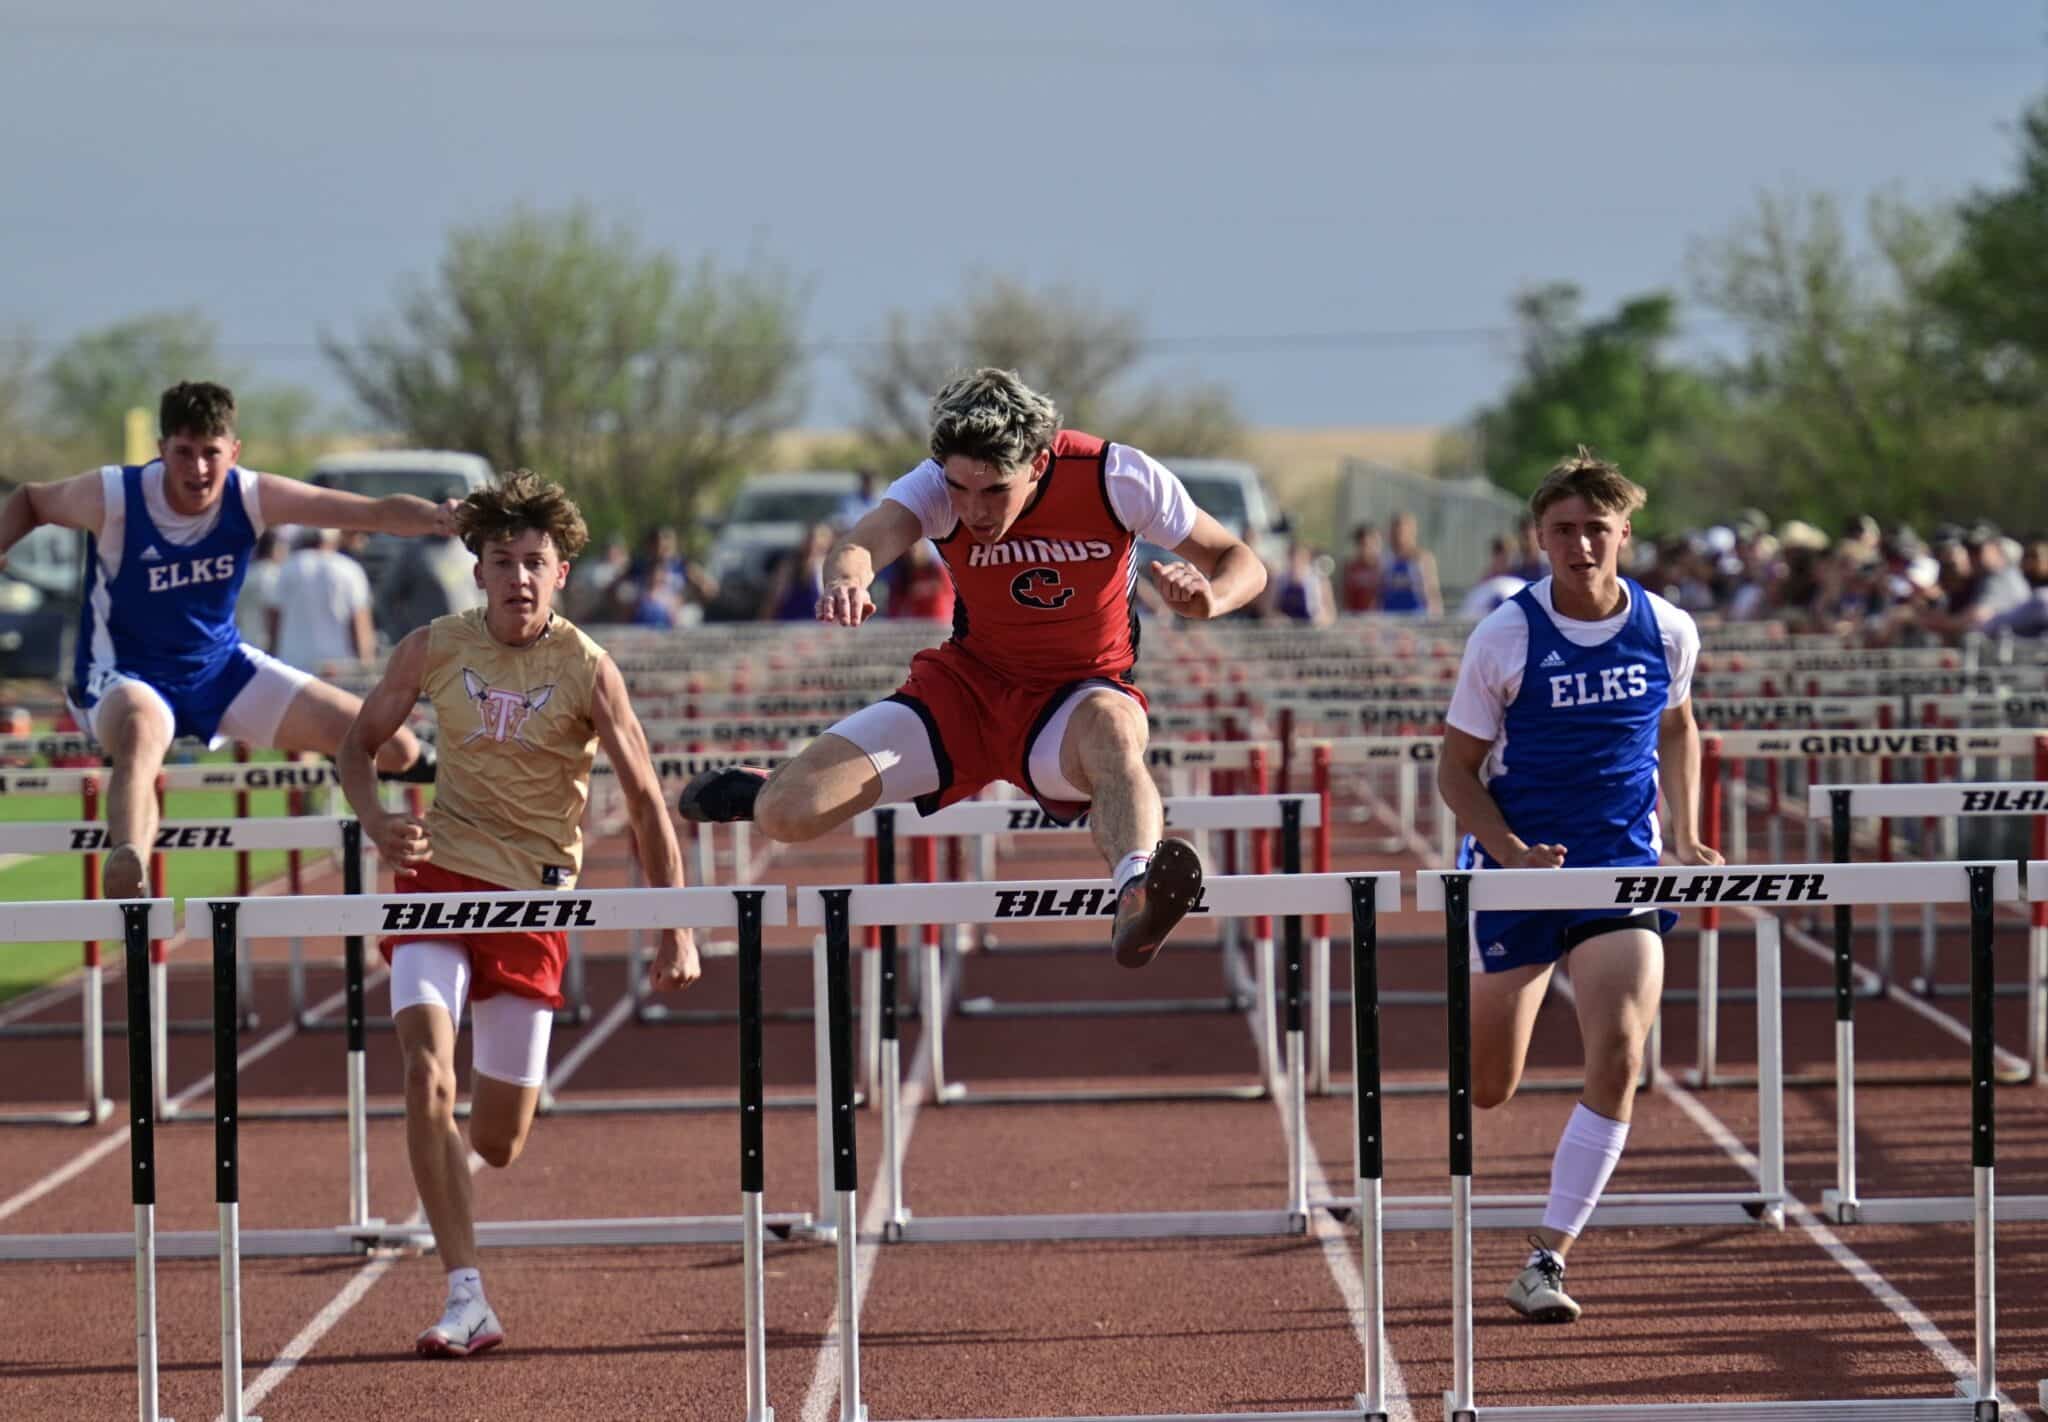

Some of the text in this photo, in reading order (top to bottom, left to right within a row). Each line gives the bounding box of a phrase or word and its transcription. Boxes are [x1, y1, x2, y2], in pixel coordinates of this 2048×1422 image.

[148, 554, 234, 592] ELKS
[1549, 664, 1648, 708] ELKS
[1690, 703, 1813, 719] RUVER
[1800, 736, 1958, 754] GRUVER
[1962, 790, 2048, 812] BLA
[70, 827, 234, 850] BZER
[994, 887, 1210, 918] BLA
[1614, 873, 1828, 903] BLAZER
[382, 899, 596, 931] BLAZER
